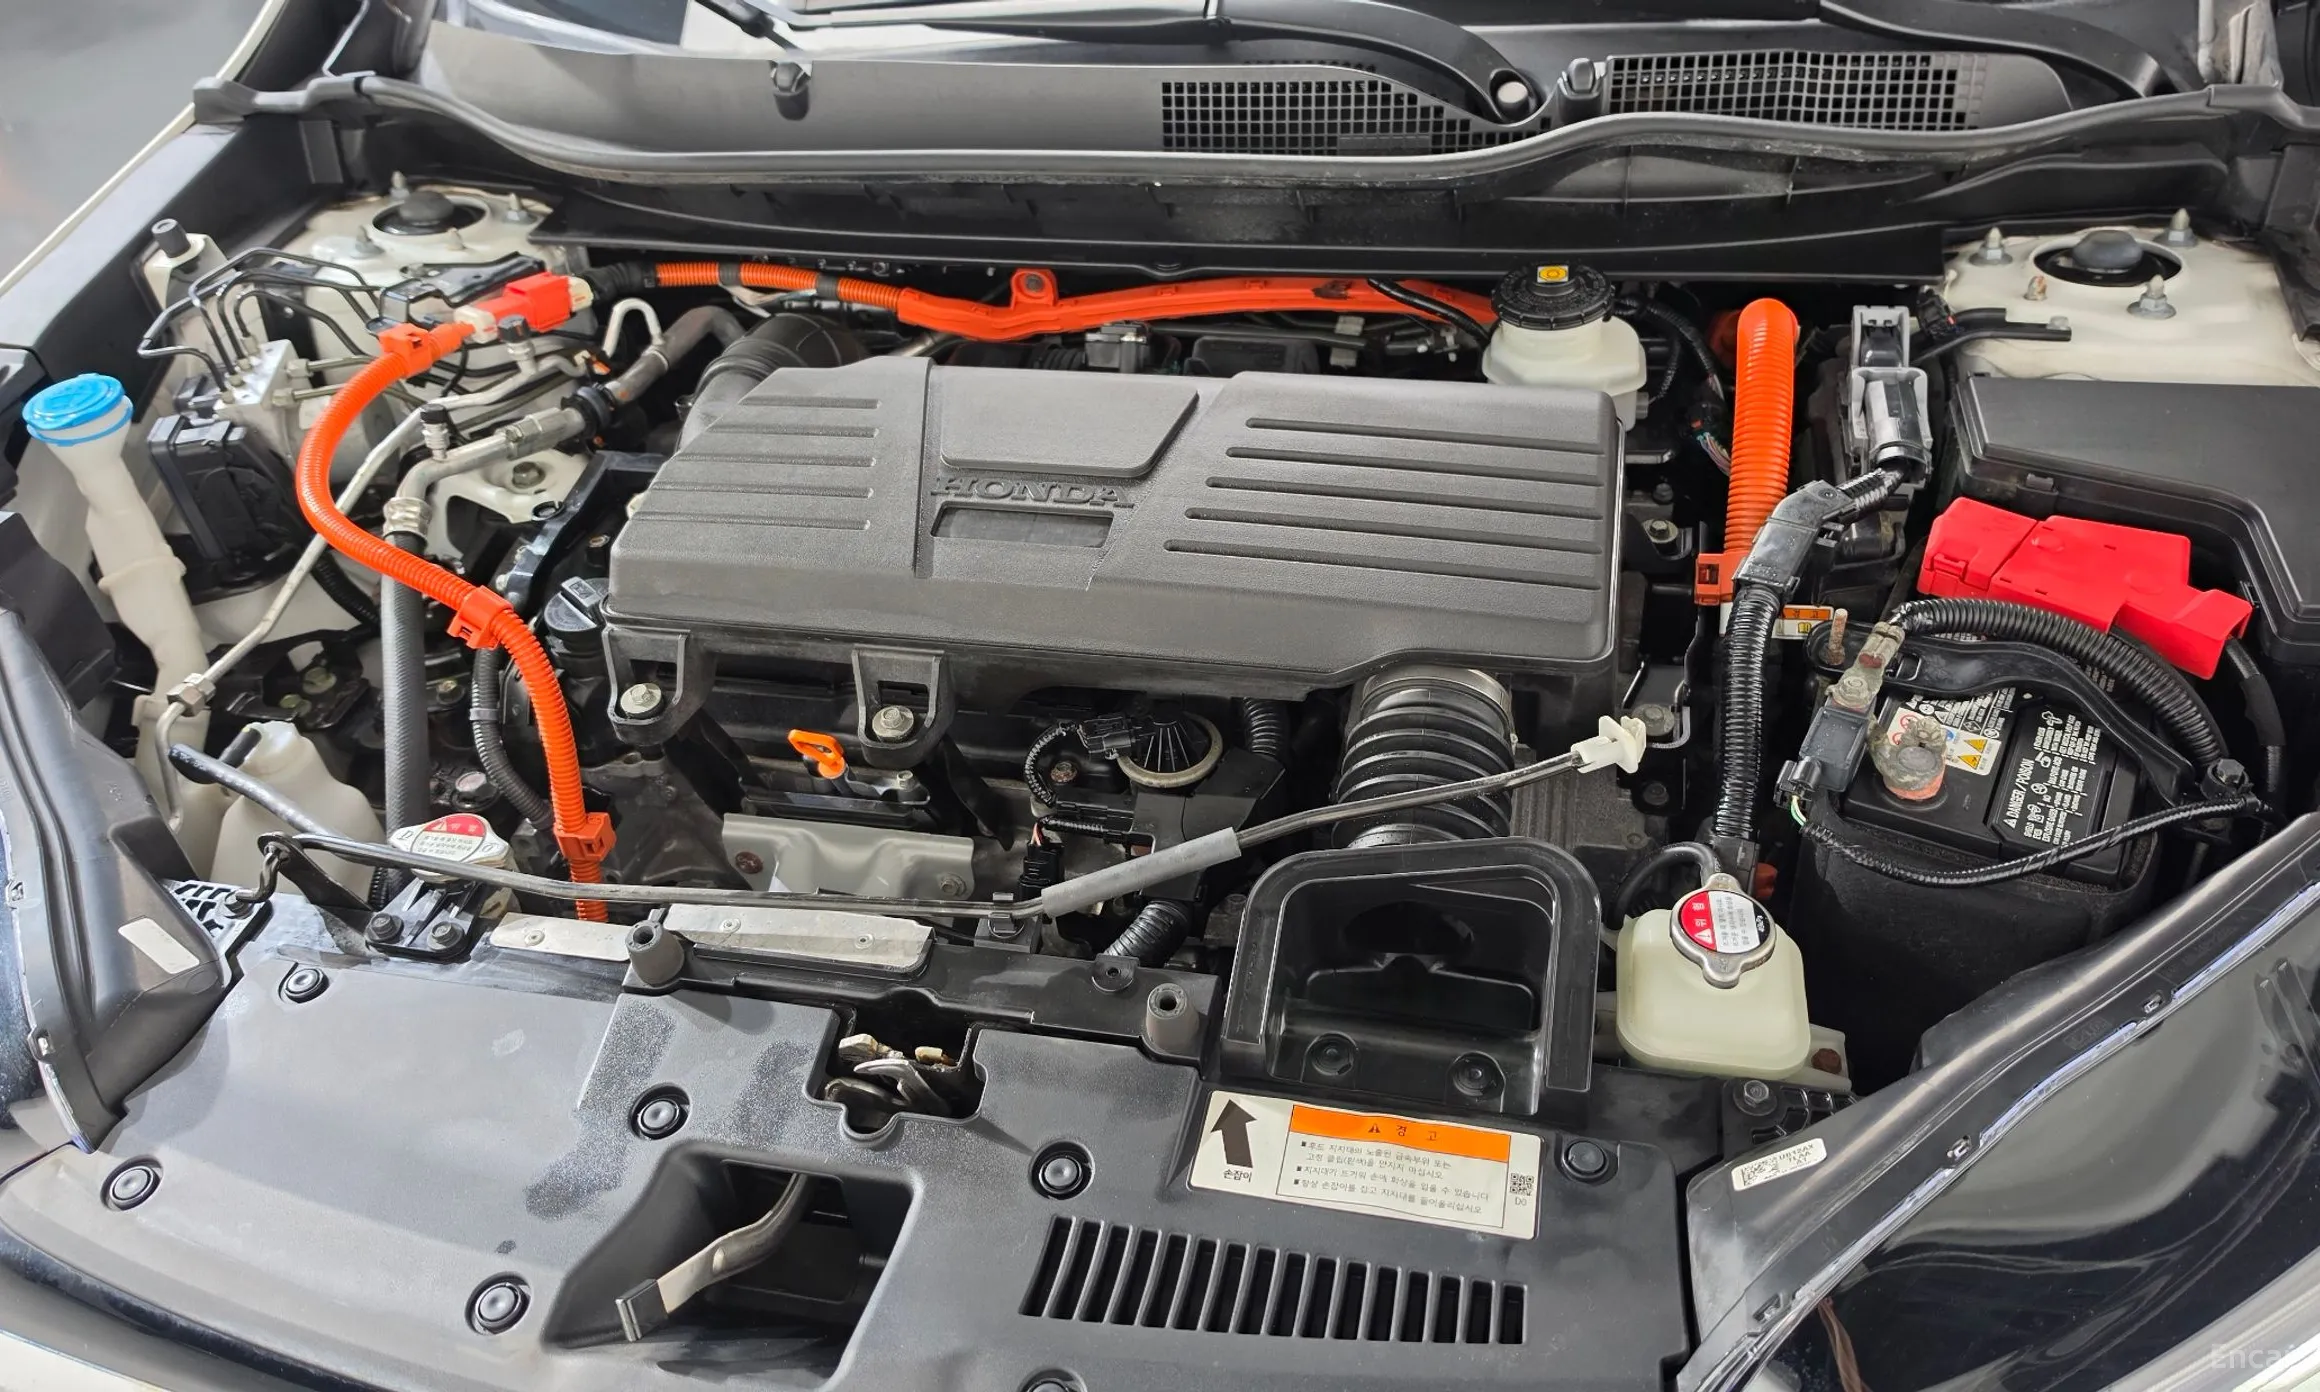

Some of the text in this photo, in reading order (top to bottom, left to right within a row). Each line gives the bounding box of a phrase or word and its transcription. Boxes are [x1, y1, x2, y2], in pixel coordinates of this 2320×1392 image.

[930, 477, 1135, 509] HONDA
[1397, 1125, 1437, 1142] 경 고
[1308, 1142, 1325, 1151] 후드
[1306, 1152, 1323, 1161] 고정
[1379, 1159, 1405, 1173] 만지지
[1408, 1166, 1444, 1180] 마십시오
[1223, 1167, 1253, 1183] 손잡이
[1322, 1180, 1356, 1193] 손잡이를
[1360, 1184, 1377, 1196] 잡고
[1441, 1186, 1450, 1195] 수
[1454, 1186, 1489, 1202] 있습니다
